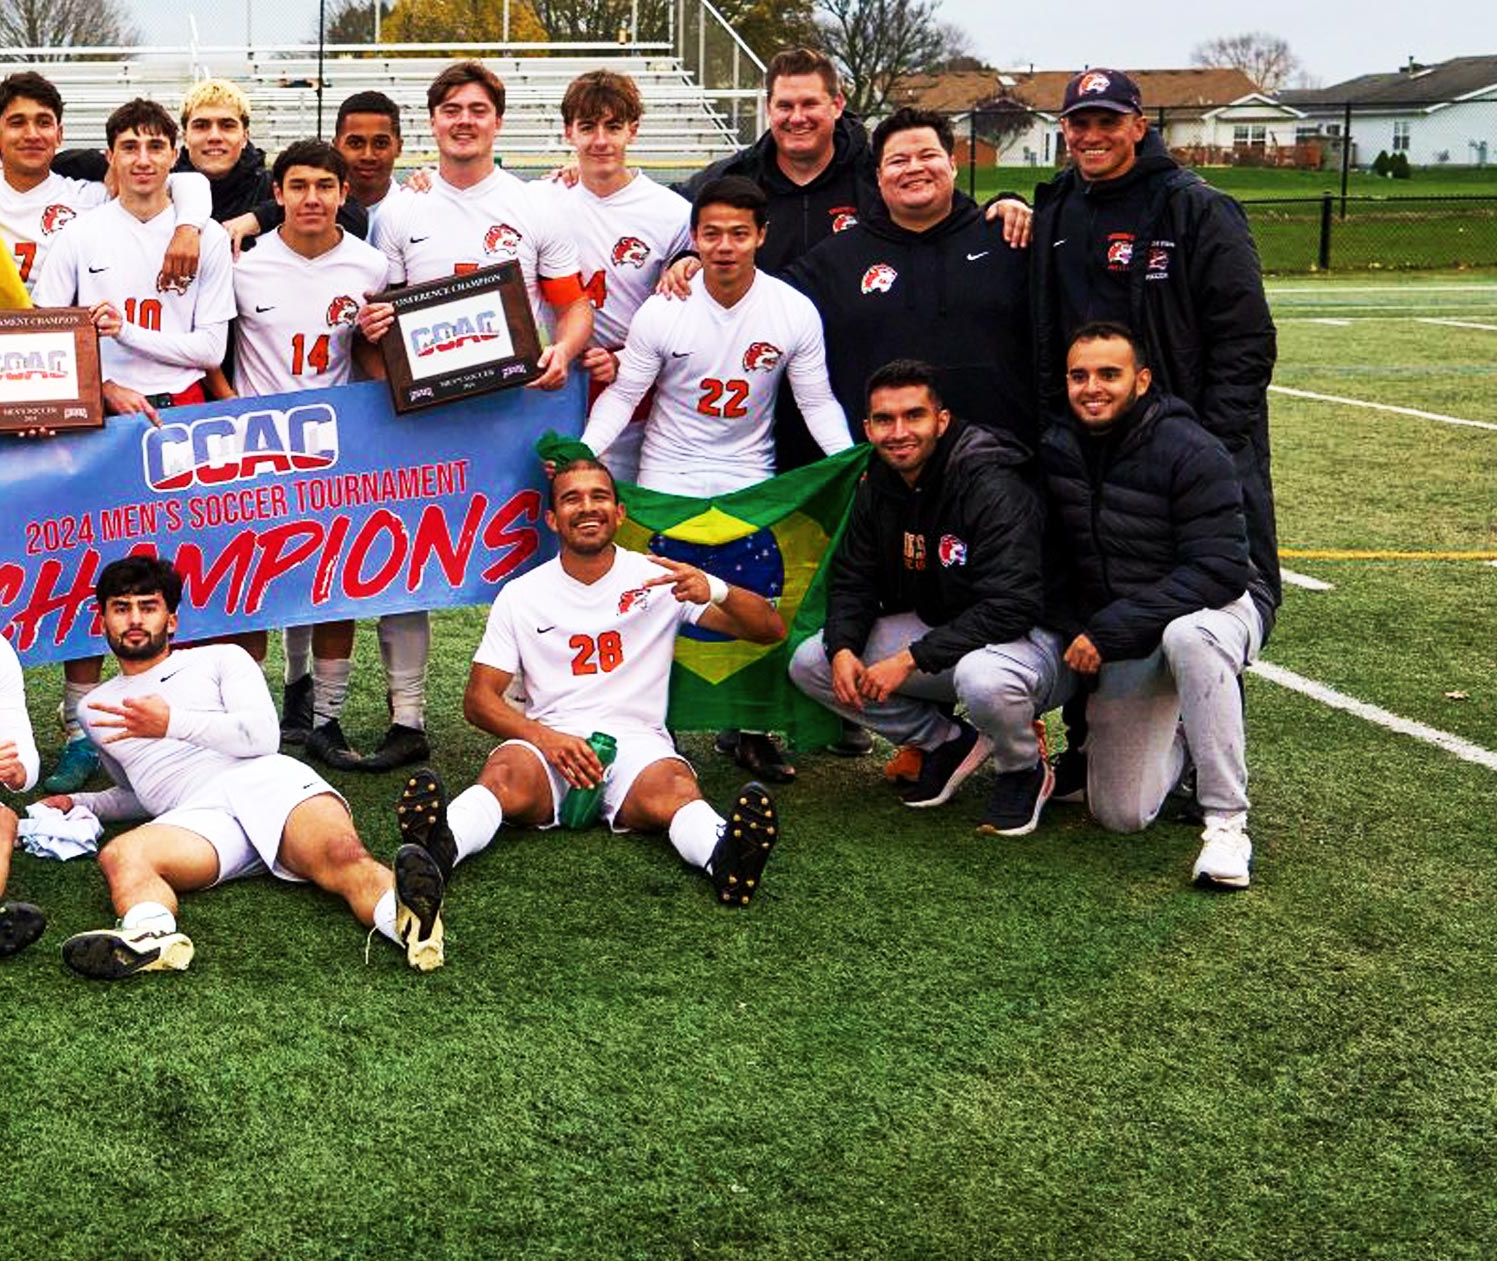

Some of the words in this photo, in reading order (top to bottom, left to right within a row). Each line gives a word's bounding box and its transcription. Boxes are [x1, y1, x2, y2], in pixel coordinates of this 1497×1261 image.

[395, 287, 451, 307] ONFERENCE
[451, 274, 501, 293] CHAMPION
[30, 316, 79, 326] CHAMPION
[124, 297, 163, 332] 10
[410, 310, 500, 357] CCAC
[291, 332, 330, 376] 14
[696, 377, 749, 418] 22
[143, 404, 338, 492] CCAC
[25, 516, 94, 555] 2024
[101, 498, 182, 542] MEN'S
[189, 485, 288, 527] SOCCER
[294, 459, 469, 515] TOURNAMENT
[568, 629, 624, 677] 28
